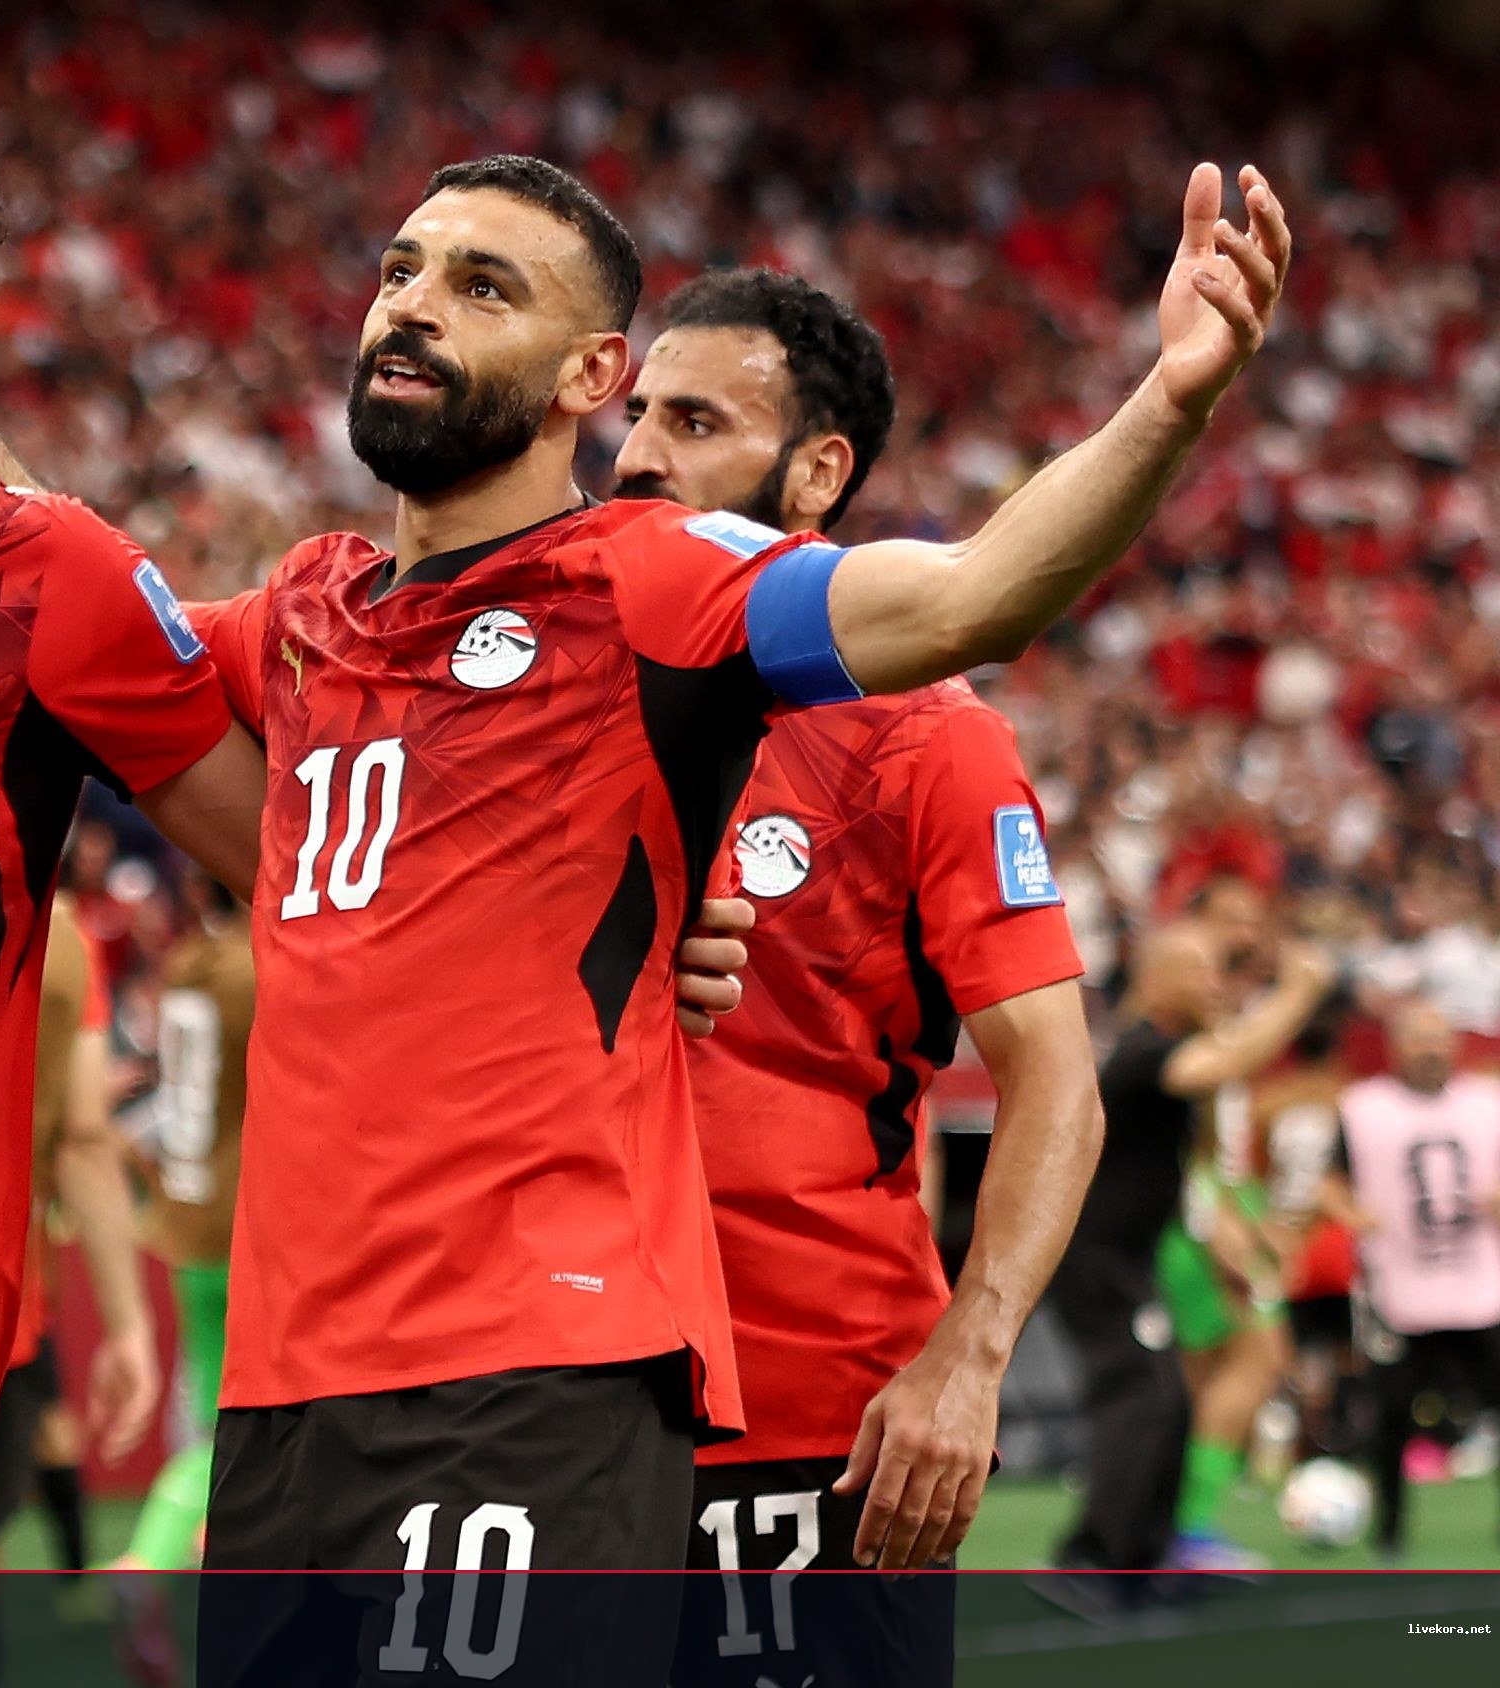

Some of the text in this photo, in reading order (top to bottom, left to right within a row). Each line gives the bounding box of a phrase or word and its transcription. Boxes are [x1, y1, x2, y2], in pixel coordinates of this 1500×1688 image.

[280, 736, 406, 921] 10
[378, 1502, 535, 1681] 10
[698, 1488, 823, 1658] 17
